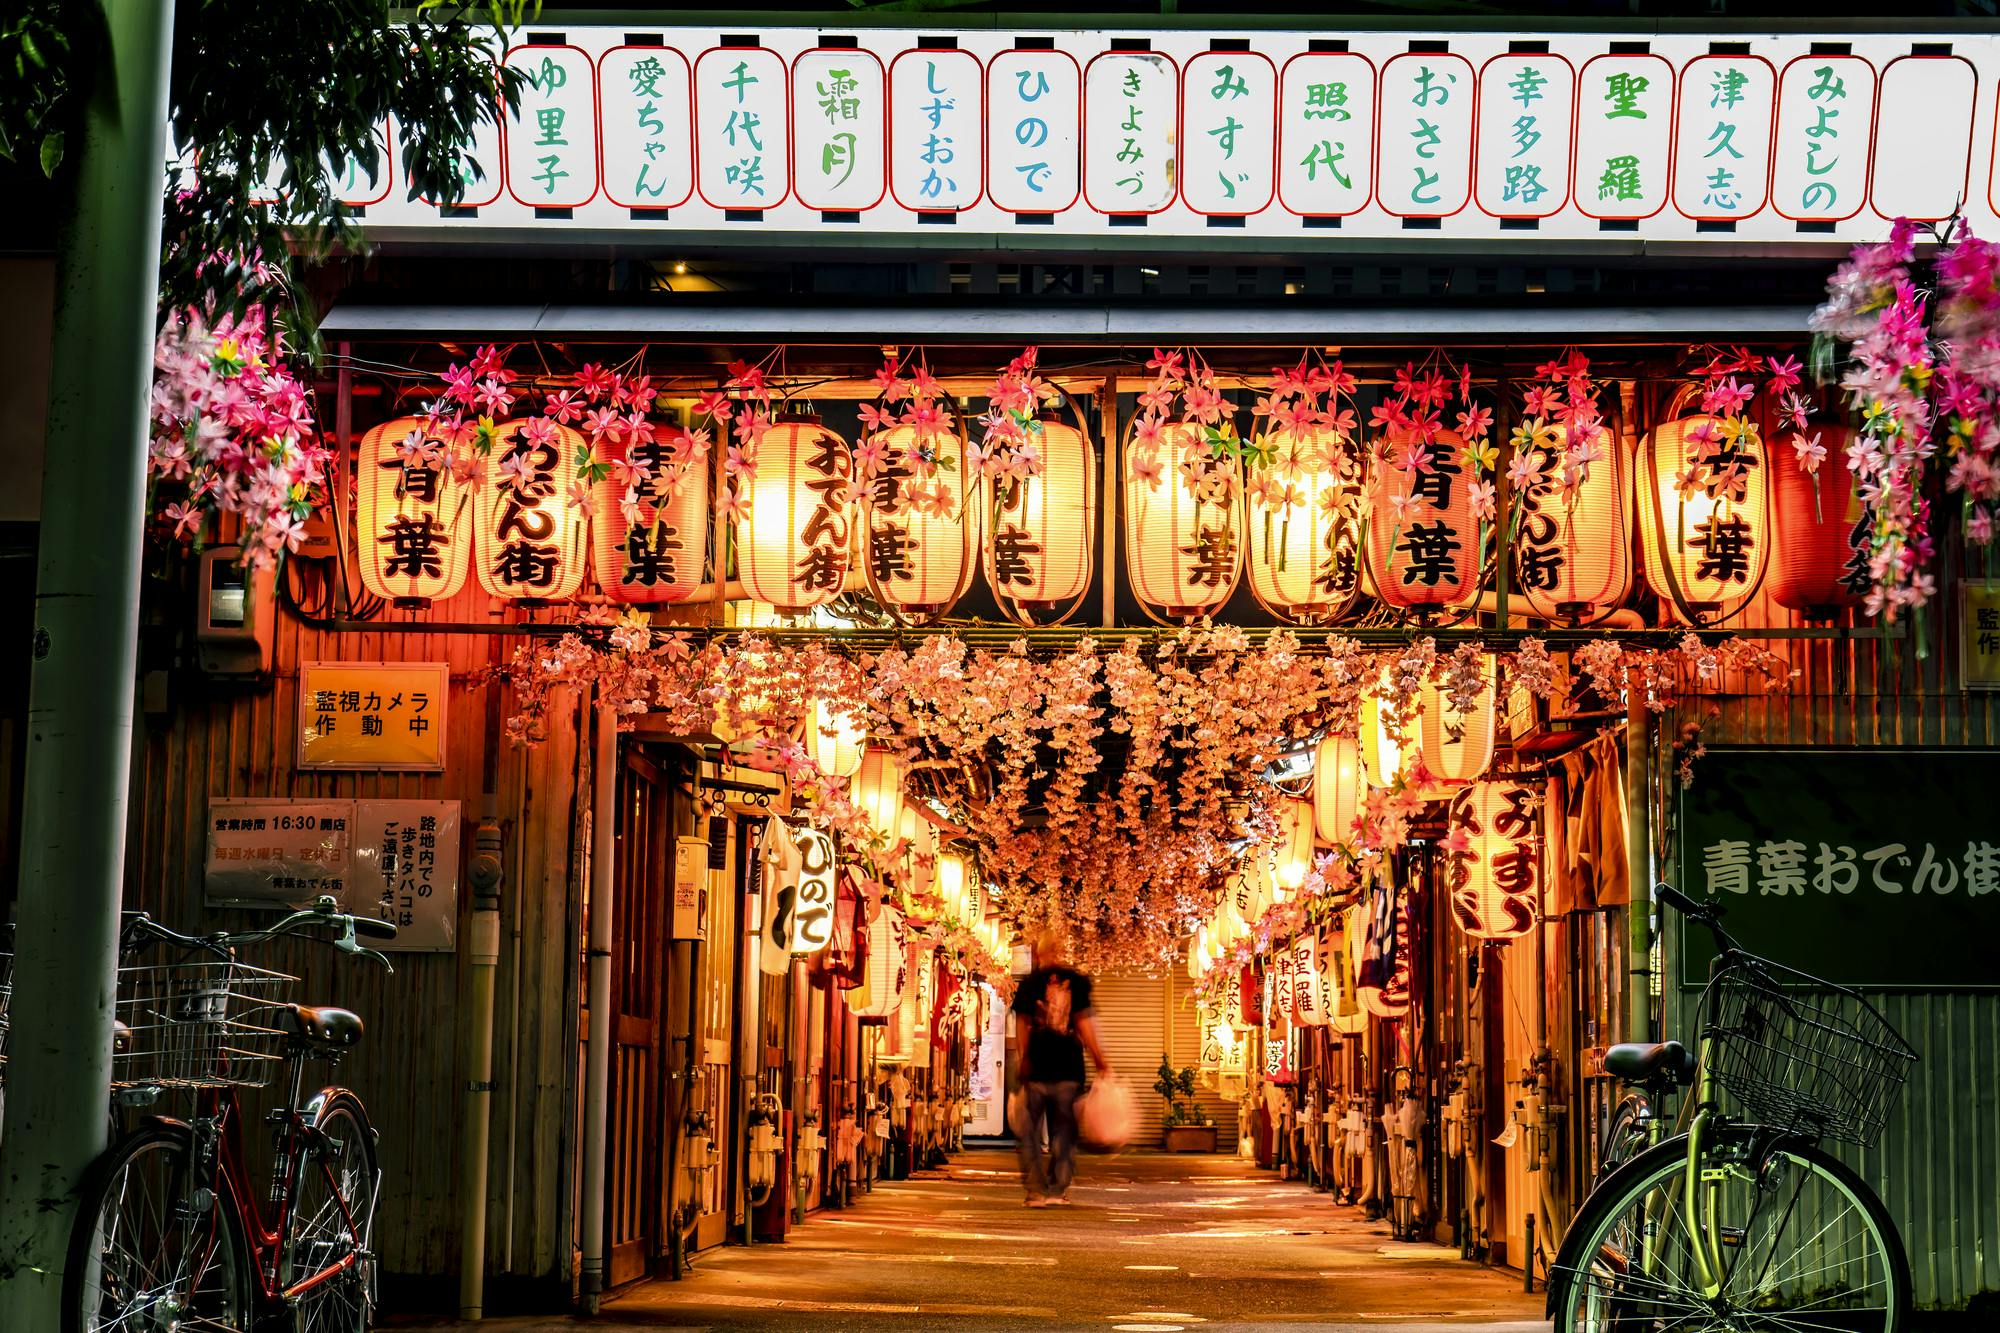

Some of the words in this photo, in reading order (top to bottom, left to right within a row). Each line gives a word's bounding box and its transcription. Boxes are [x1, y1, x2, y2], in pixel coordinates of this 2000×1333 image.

[528, 56, 570, 194] ゆ里子
[629, 56, 666, 197] 愛ちゃん
[721, 61, 764, 197] 千代咲
[816, 69, 860, 191] 霜月
[919, 61, 958, 197] しずおか
[1015, 70, 1050, 193] ひので
[1115, 68, 1143, 194] きよみづ
[1300, 82, 1353, 190] 照代
[1409, 66, 1457, 205] おさと
[1502, 66, 1549, 205] 幸多路
[1598, 72, 1650, 202] 聖羅
[1702, 68, 1750, 210] 津久志
[1801, 65, 1848, 212] みよしの
[791, 432, 852, 594] おでん街
[315, 691, 430, 713] 監視カメラ
[215, 818, 267, 831] 営業時間
[272, 816, 316, 830] 16:30
[319, 818, 346, 831] 開店
[215, 848, 284, 860] 毎週水曜日
[272, 878, 343, 890] 青葉おでん街
[399, 827, 417, 927] 歩きタバコは
[417, 816, 437, 898] 路地内での
[797, 836, 833, 944] ひので
[1276, 957, 1294, 1013] 津久志
